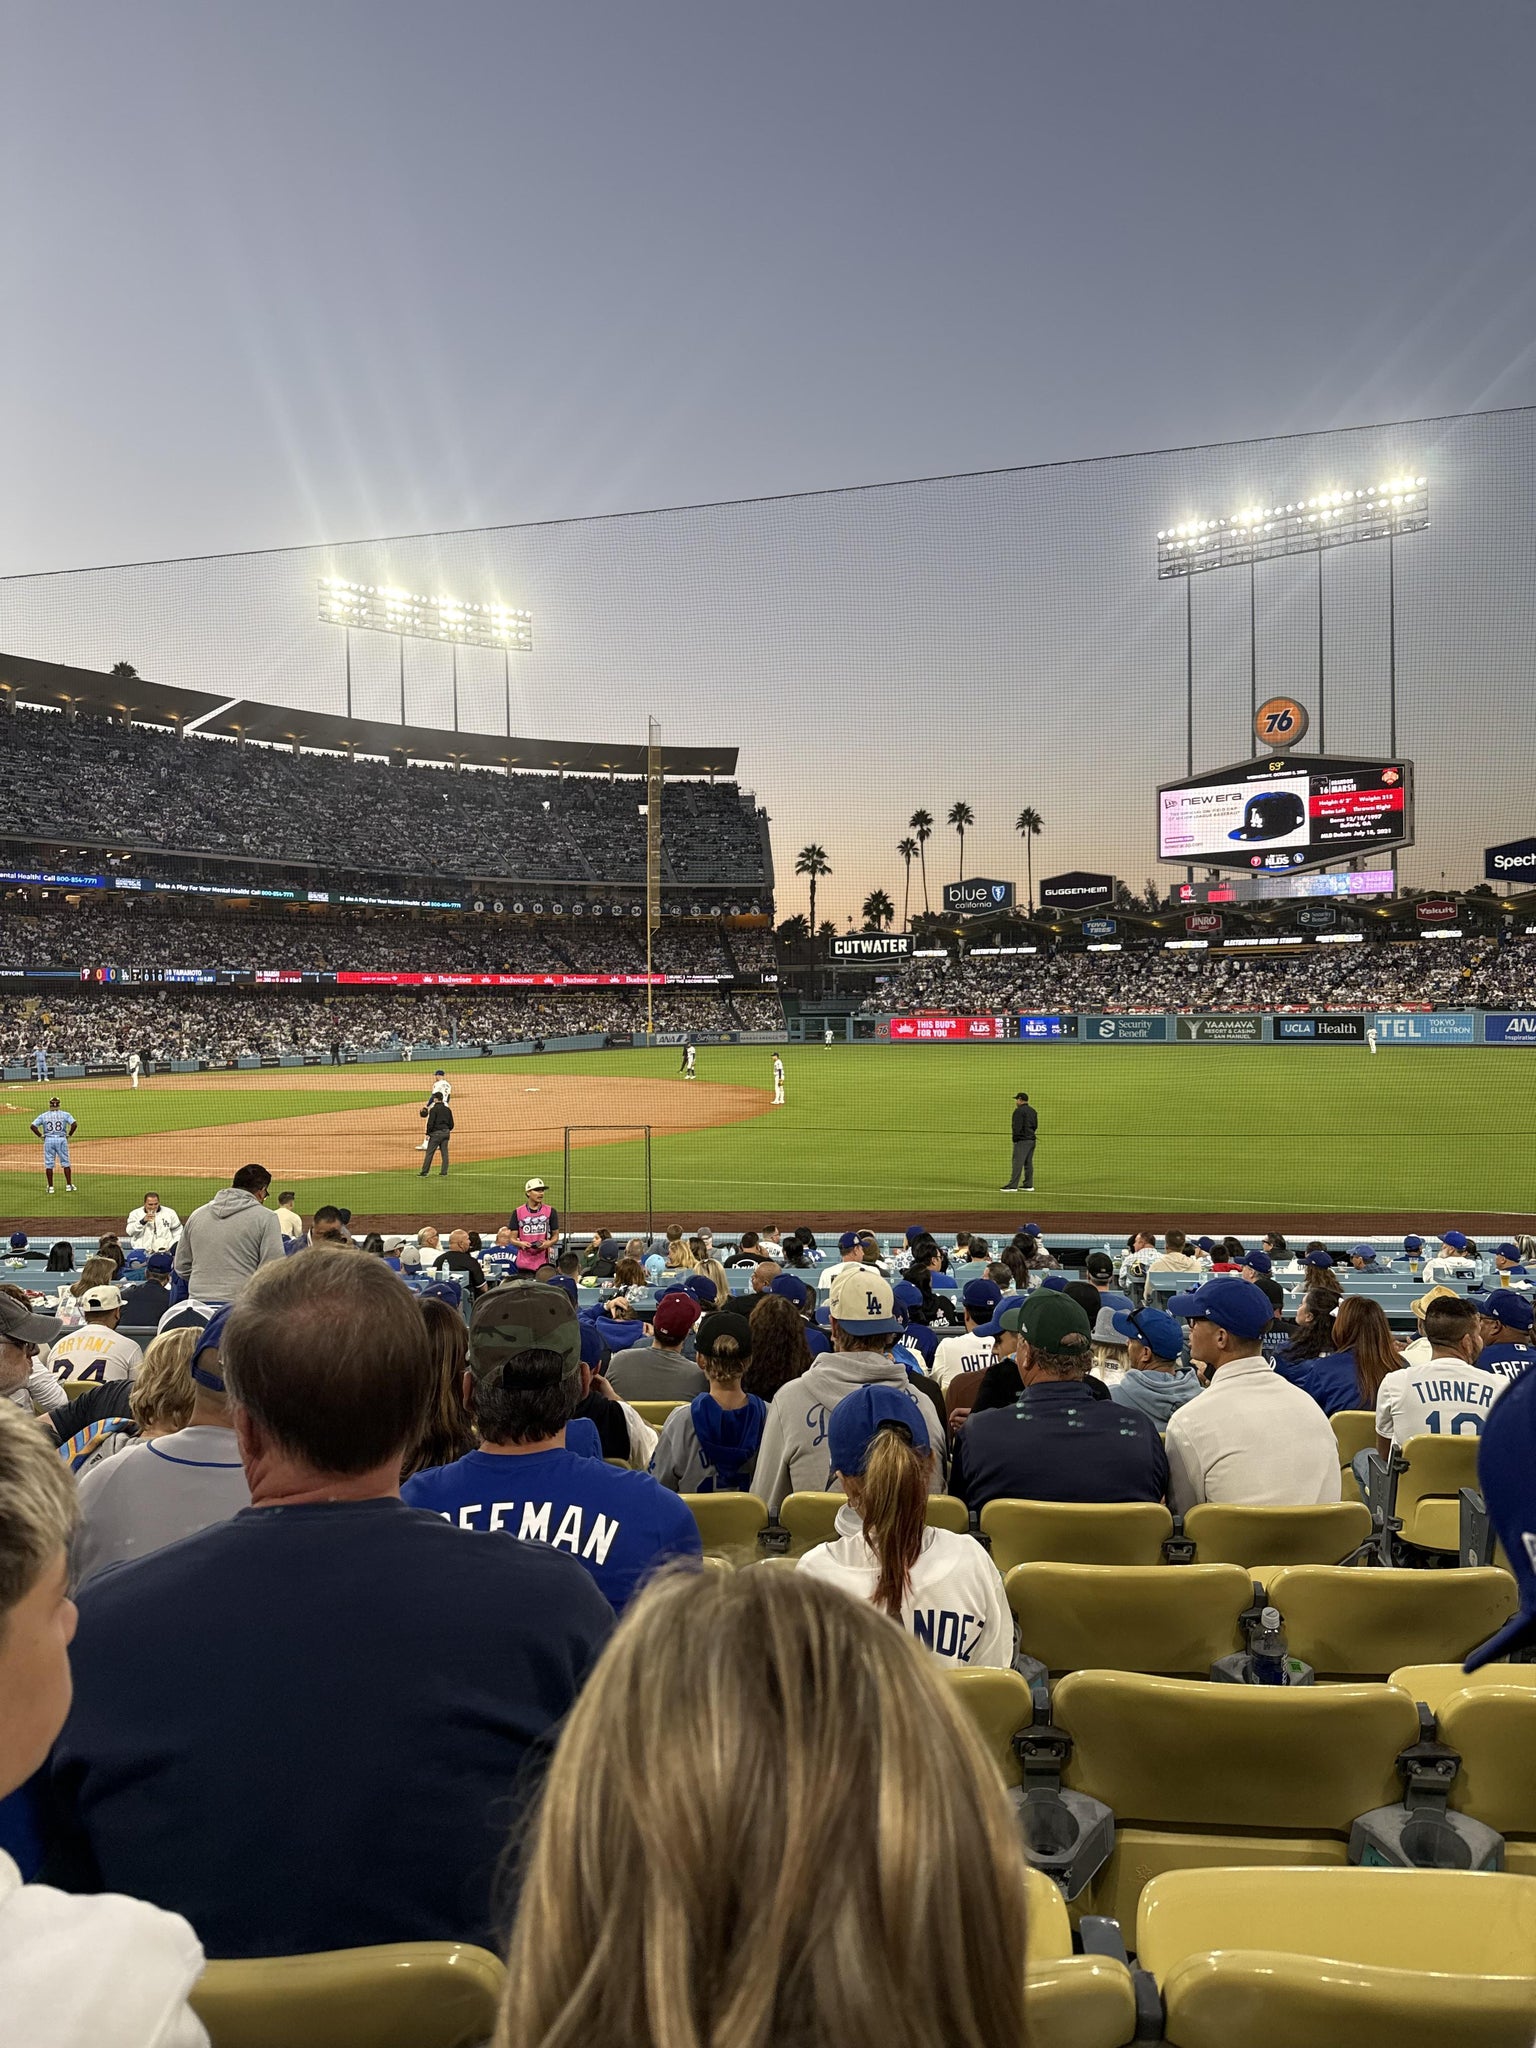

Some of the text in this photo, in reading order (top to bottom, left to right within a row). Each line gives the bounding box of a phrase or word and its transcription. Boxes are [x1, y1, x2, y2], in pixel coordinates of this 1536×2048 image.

[1264, 709, 1293, 733] 76
[1331, 784, 1356, 793] MARSH
[1266, 856, 1289, 866] NLDS
[950, 886, 987, 901] blue
[1045, 887, 1108, 896] GUGGENHEIM
[1420, 906, 1455, 914] Yakult
[1191, 916, 1216, 926] JINRO
[834, 938, 907, 955] CUTWATER
[96, 969, 102, 979] 0
[110, 969, 116, 979] 0
[626, 976, 661, 984] Budweser
[878, 1026, 889, 1034] 76
[1118, 1020, 1152, 1030] Security
[1284, 1024, 1310, 1032] UCLA
[1318, 1023, 1357, 1034] Health
[1378, 1020, 1422, 1038] TEL
[1506, 1018, 1536, 1032] AN
[47, 1121, 62, 1132] 38
[162, 1218, 169, 1227] LA
[490, 1252, 517, 1262] FREEMAN
[866, 1292, 882, 1315] LA
[57, 1337, 116, 1354] BRYANT
[53, 1359, 108, 1382] 24
[1412, 1380, 1494, 1407] TURNER
